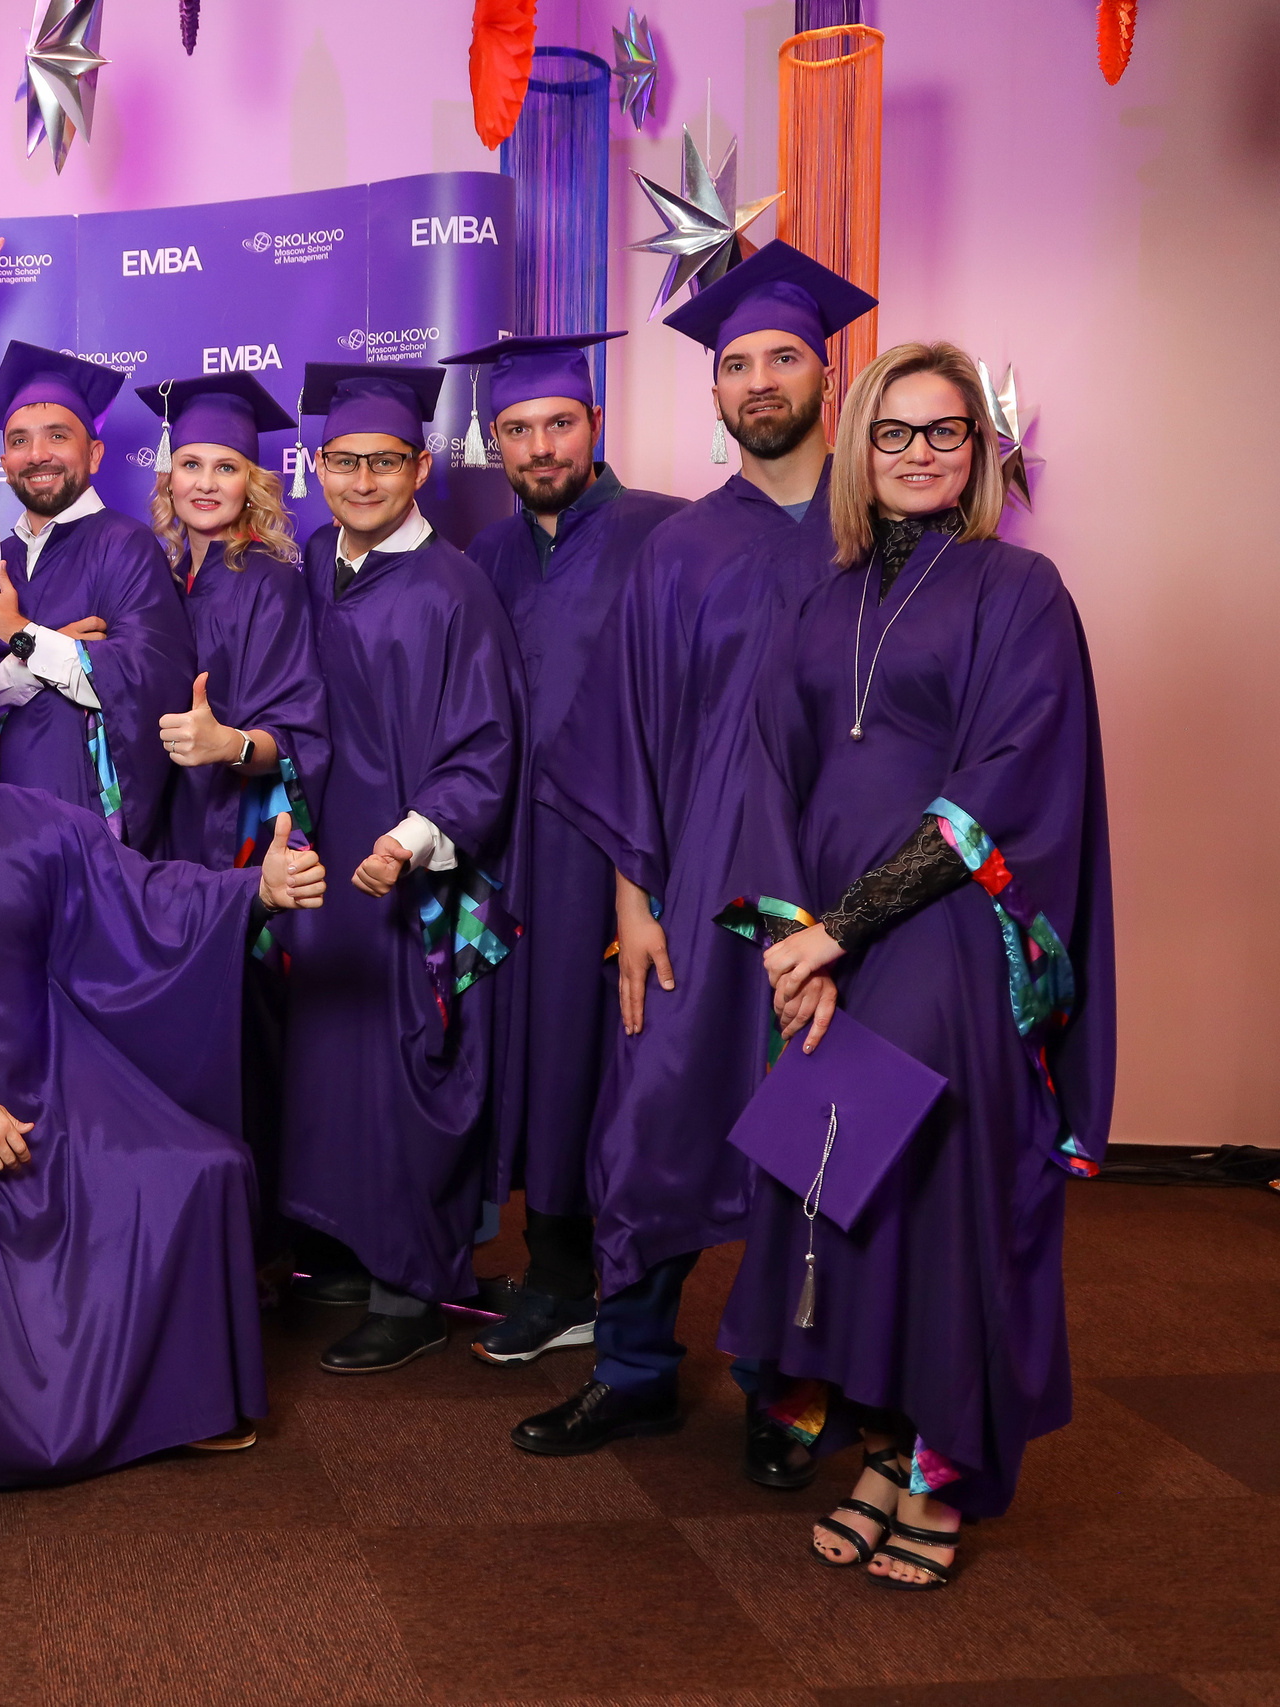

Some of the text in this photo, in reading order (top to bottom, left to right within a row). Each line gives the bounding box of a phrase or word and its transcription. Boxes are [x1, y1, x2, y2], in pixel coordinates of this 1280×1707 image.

[274, 228, 345, 248] SKOLKOVO
[411, 215, 499, 247] EMBA
[274, 243, 333, 257] Moscow School
[274, 252, 329, 265] of Management
[122, 245, 203, 277] EMBA
[14, 267, 41, 276] School
[367, 327, 440, 346] SKOLKOVO
[368, 342, 427, 355] Moscow School
[368, 350, 422, 362] of Management
[203, 343, 283, 374] EMBA
[283, 446, 322, 474] EM
